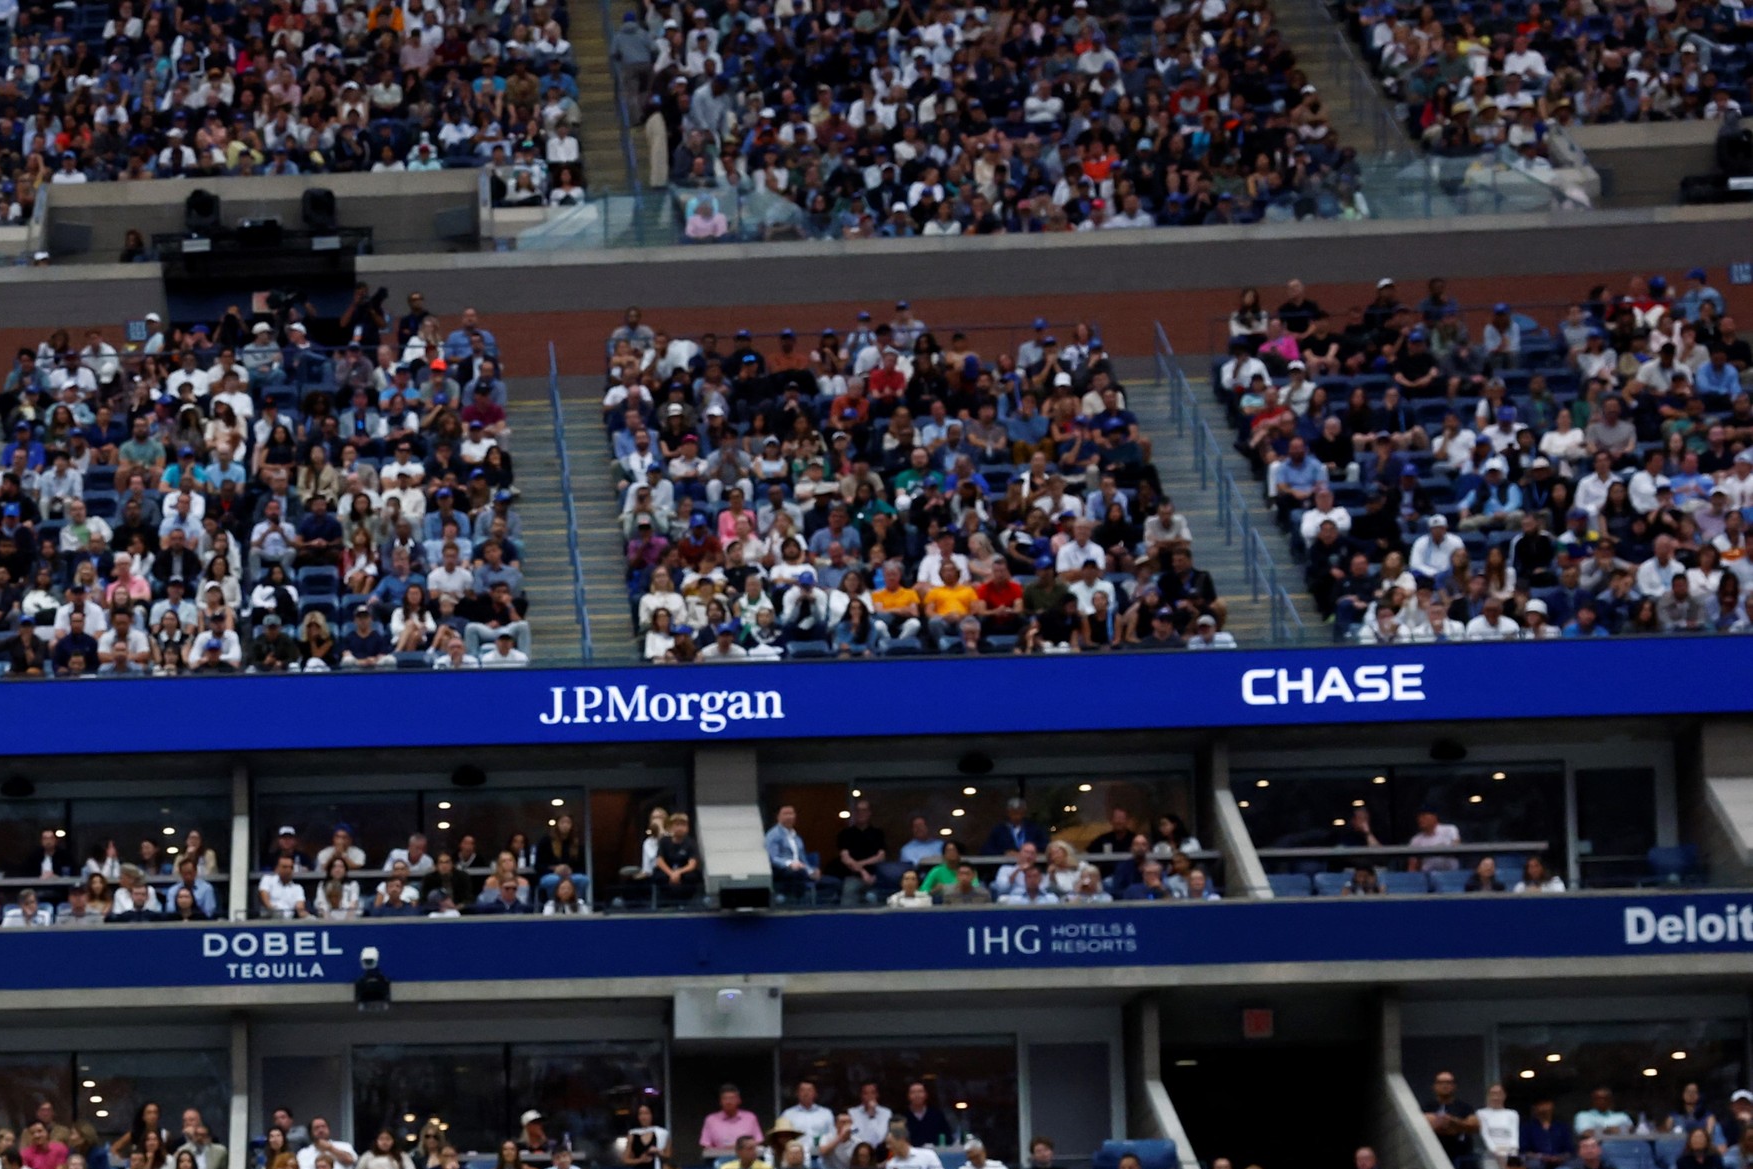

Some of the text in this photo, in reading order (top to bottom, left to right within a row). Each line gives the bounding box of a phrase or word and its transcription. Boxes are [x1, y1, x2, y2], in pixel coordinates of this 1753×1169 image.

[1241, 664, 1426, 705] CHASE
[539, 685, 785, 733] J.P.Morgan
[967, 924, 1042, 955] IHG
[1050, 922, 1137, 938] HOTELS &
[202, 931, 343, 957] DOBEL
[1050, 938, 1138, 954] RESORTS
[226, 962, 325, 979] TEQUILA
